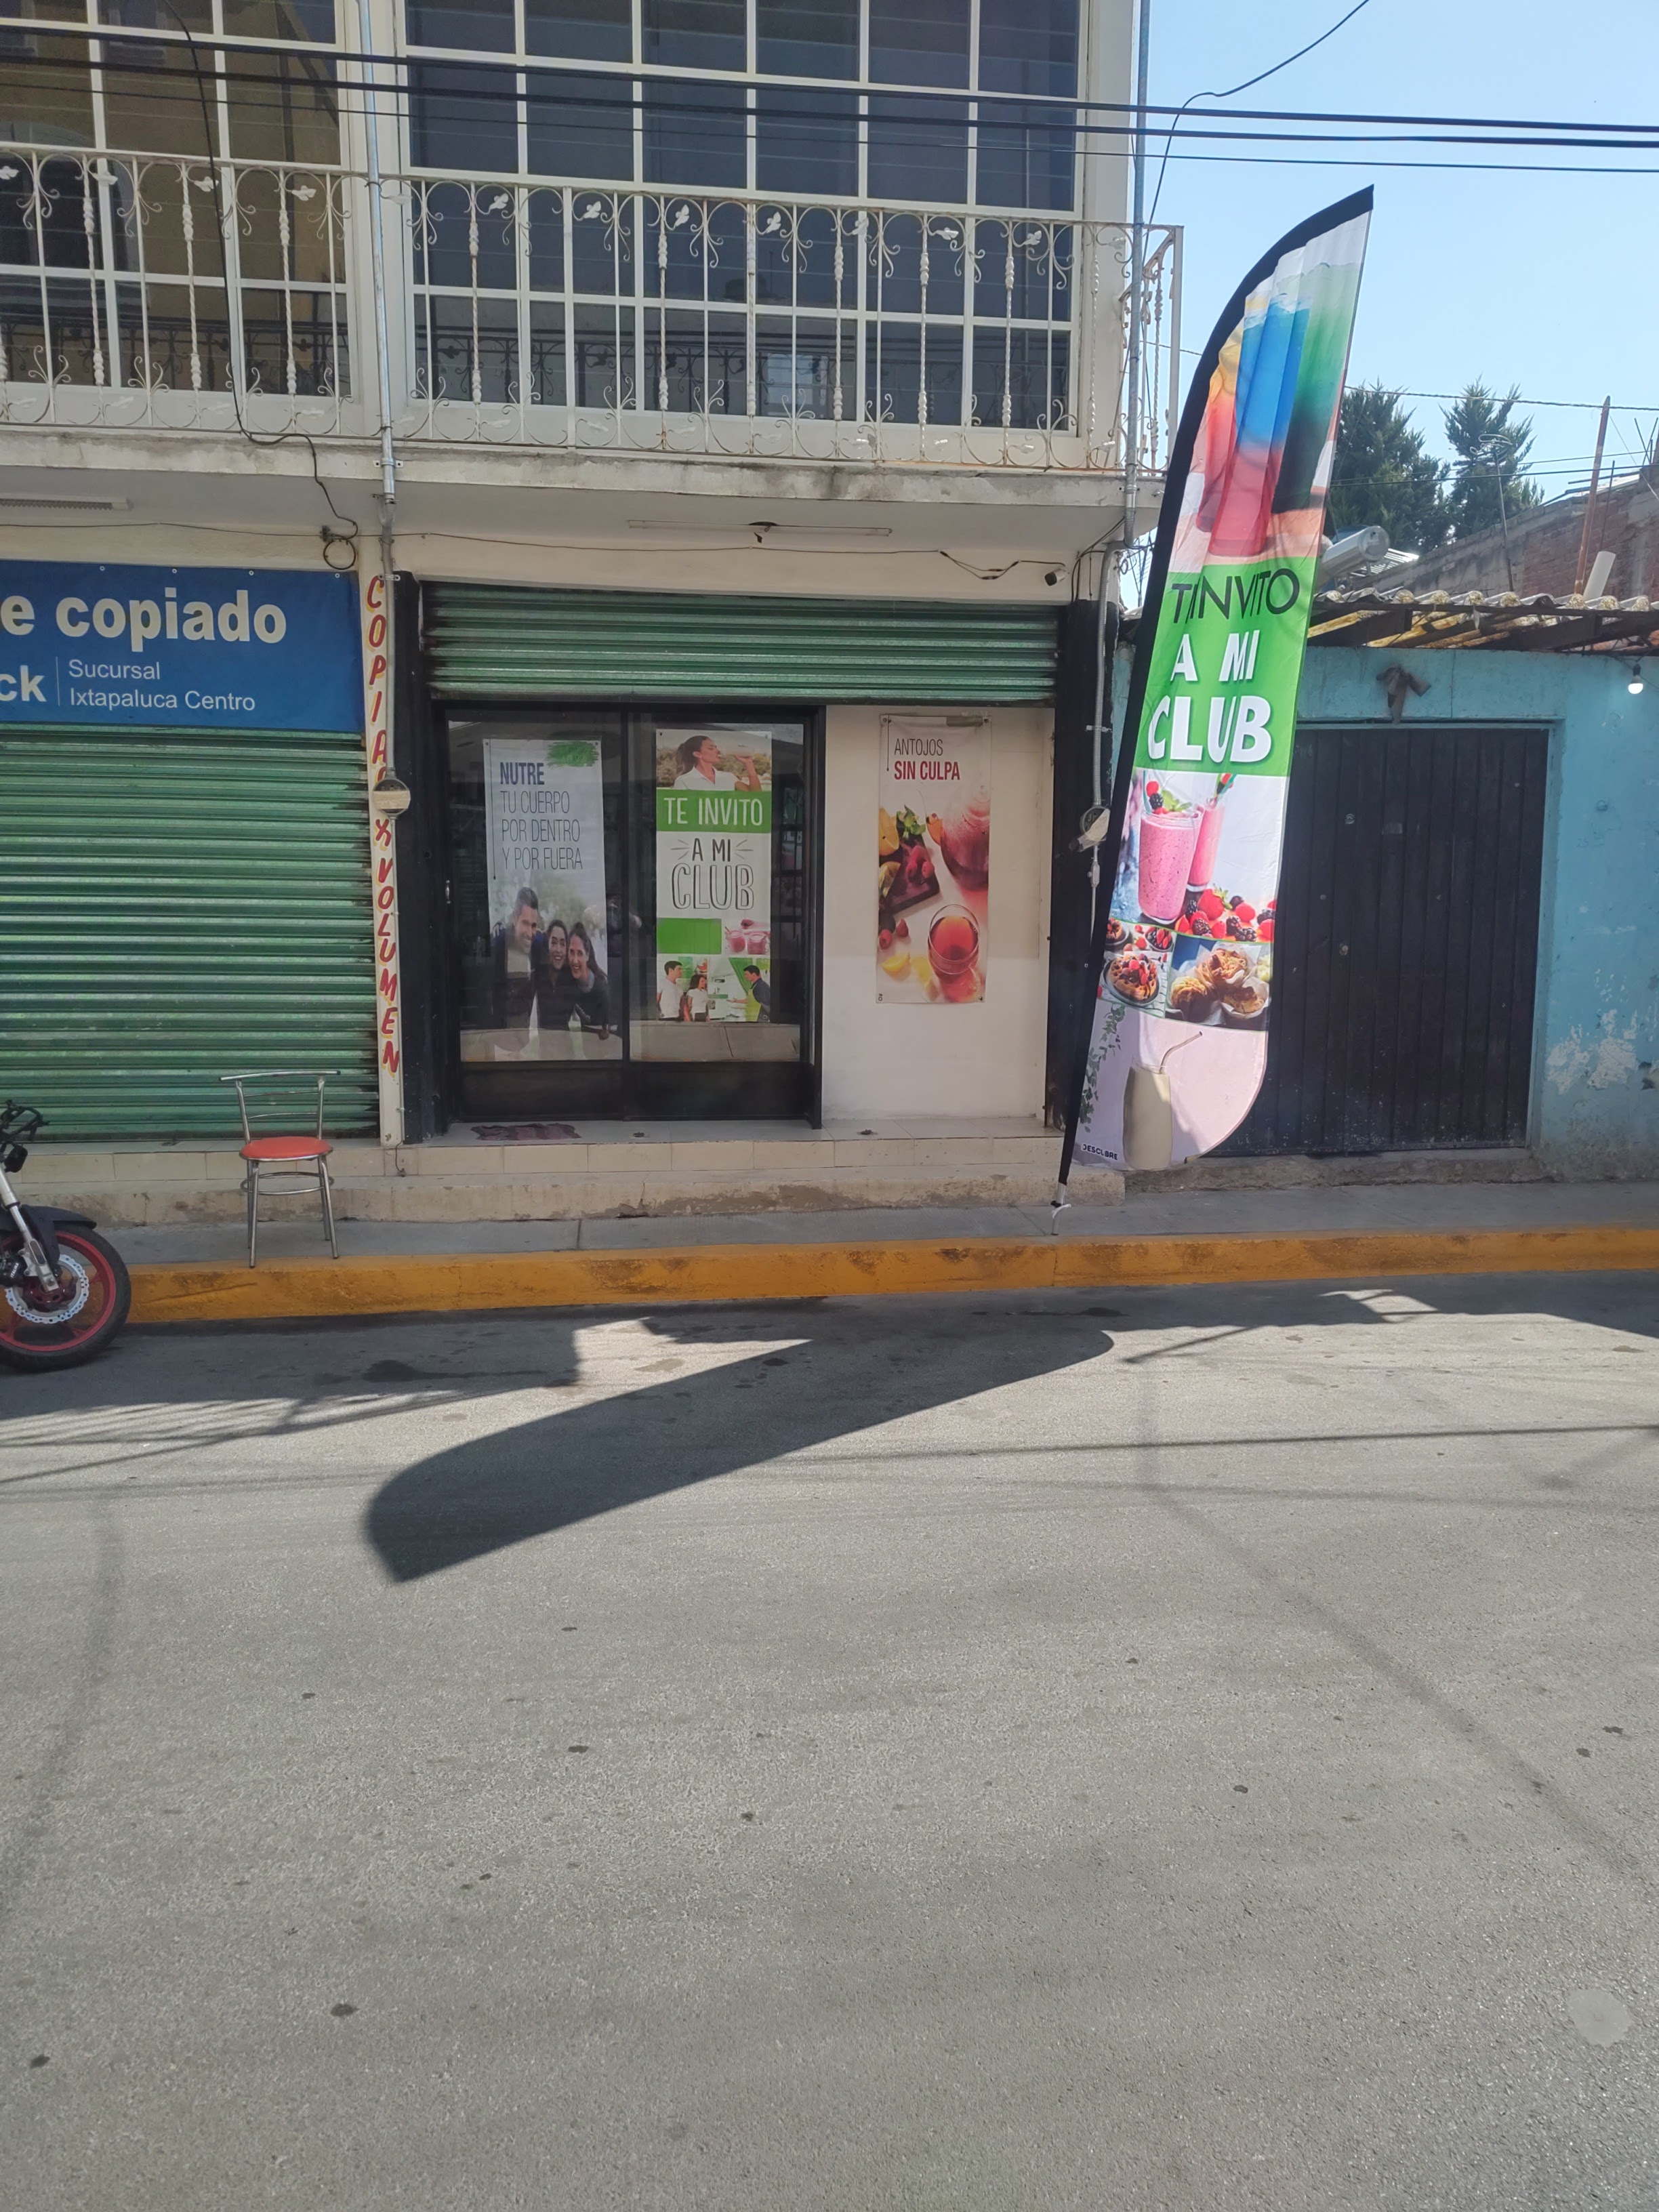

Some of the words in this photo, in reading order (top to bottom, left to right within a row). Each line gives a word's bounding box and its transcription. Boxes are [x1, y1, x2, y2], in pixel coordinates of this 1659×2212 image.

[56, 587, 287, 652] copiado
[1170, 634, 1198, 681] A
[1218, 630, 1260, 681] MI
[68, 659, 161, 680] Sucursal
[70, 687, 178, 710] Ixtapaluca
[184, 690, 255, 711] Centro
[1147, 695, 1271, 763] CLUB
[894, 738, 943, 756] ANTOJOS
[499, 762, 545, 785] NUTRE
[894, 760, 916, 780] SIN
[920, 760, 960, 780] CULPA
[500, 790, 516, 813] TU
[520, 790, 570, 814] CUERPO
[663, 797, 689, 825] TE
[698, 797, 763, 826] INVITO
[367, 575, 386, 781] COPIA
[377, 857, 399, 1073] VOLUMEN
[501, 819, 527, 842] POR
[531, 819, 580, 842] DENTRO
[502, 847, 510, 869] Y
[514, 847, 539, 869] POR
[544, 847, 583, 870] FUERA
[692, 838, 703, 862] A
[712, 838, 731, 863] MI
[672, 862, 755, 911] CLUB
